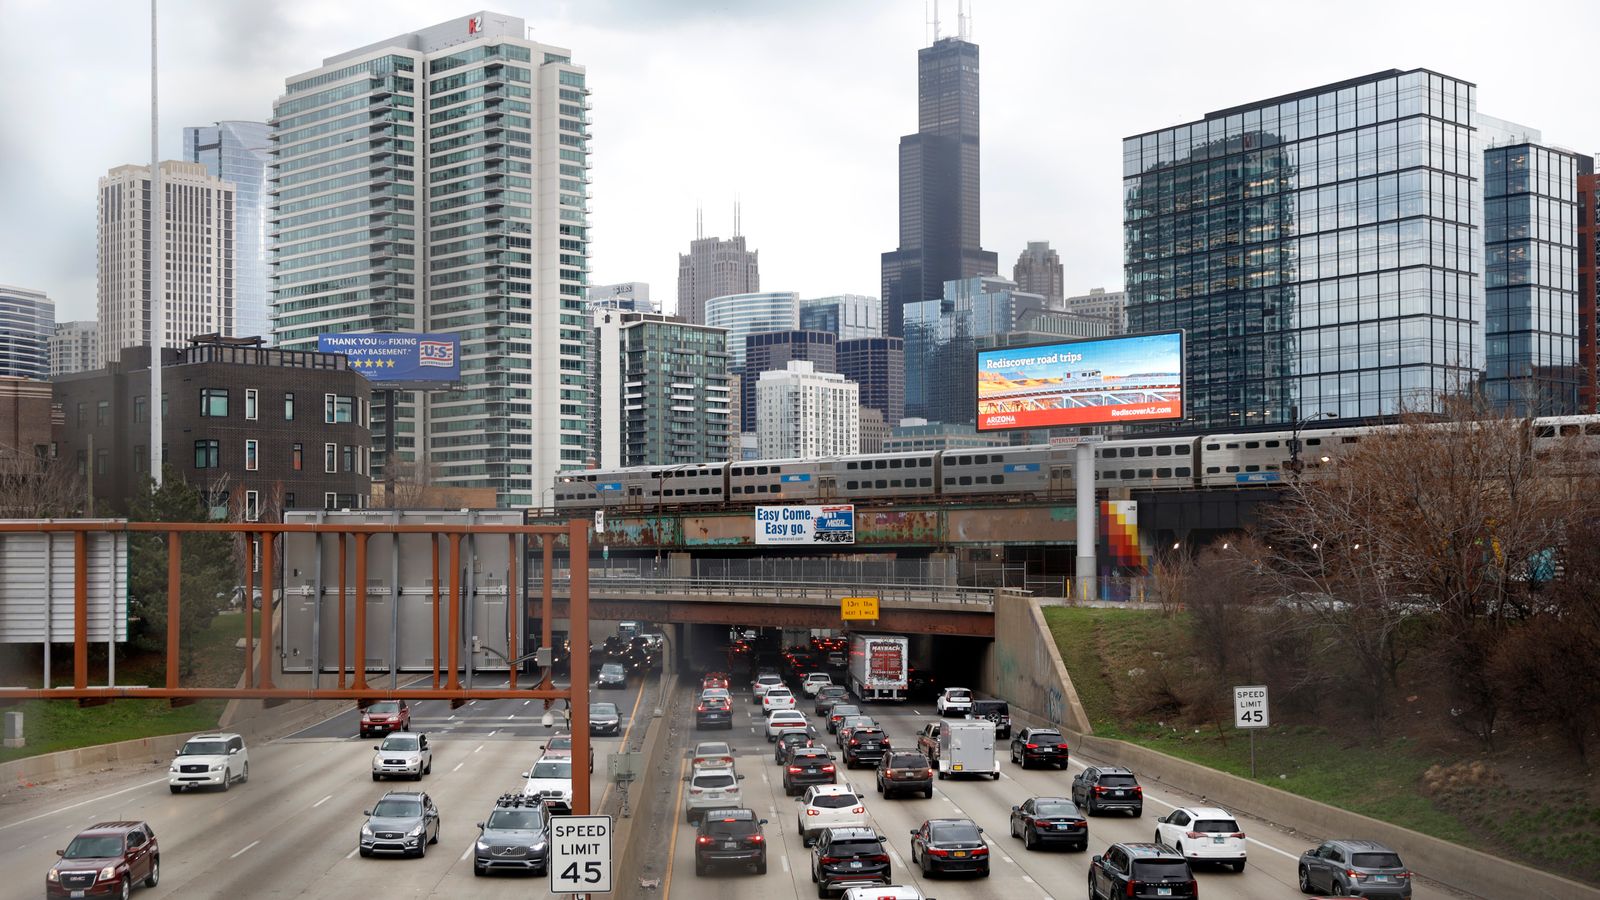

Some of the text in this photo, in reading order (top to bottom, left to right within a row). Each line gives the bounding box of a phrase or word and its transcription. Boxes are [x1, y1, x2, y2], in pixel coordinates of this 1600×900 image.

[424, 345, 450, 358] U.S.
[986, 352, 1082, 369] Rediscover road trips
[1111, 406, 1172, 417] RediscoverAZ.com
[986, 415, 1016, 423] ARIZONA
[757, 508, 814, 522] Easy Come.
[765, 522, 806, 536] Easy go.
[1240, 700, 1262, 708] LIMIT
[1241, 710, 1263, 722] 45
[555, 825, 606, 837] SPEED
[561, 843, 600, 855] LIMIT
[560, 861, 602, 884] 45
